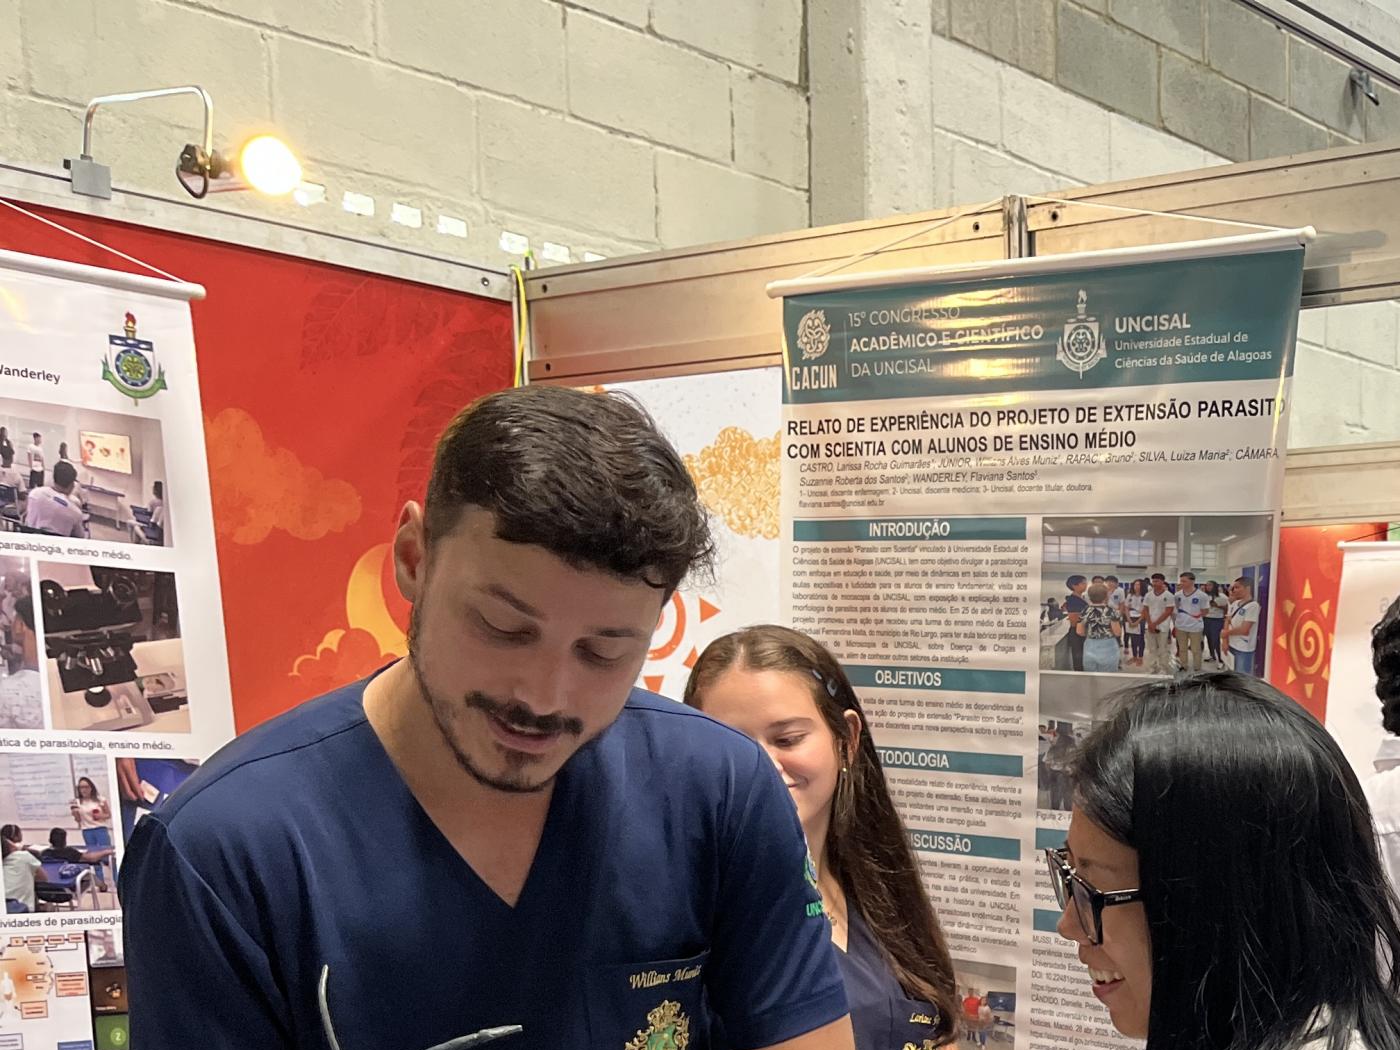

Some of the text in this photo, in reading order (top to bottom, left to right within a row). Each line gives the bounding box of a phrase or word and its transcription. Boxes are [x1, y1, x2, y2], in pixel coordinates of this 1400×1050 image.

[869, 307, 961, 326] CONGRESSO
[1115, 313, 1191, 333] UNCISAL
[850, 324, 1044, 353] ACADÊMICO E CIENTÍFICO
[1115, 332, 1249, 351] Universidade Estadual de
[851, 358, 936, 378] DA UNCISAL
[1115, 357, 1157, 369] Ciências
[1159, 355, 1173, 366] da
[1175, 352, 1206, 365] Saúde
[1210, 351, 1224, 363] de
[1227, 350, 1272, 365] Alagoas
[790, 364, 838, 391] CACUN
[787, 418, 842, 436] RELATO
[846, 417, 865, 433] DE
[870, 411, 965, 433] EXPERIÊNCIA
[969, 411, 992, 428] DO
[997, 407, 1070, 427] PROJETO
[1075, 406, 1098, 423] DE
[1103, 398, 1192, 423] EXTENSÃO
[787, 428, 1137, 460] COM SCIENTIA COM ALUNOS DE ENSINO MÉDIO
[1170, 450, 1196, 462] Luiza
[864, 472, 877, 486] dos
[969, 470, 1004, 483] Flaviana
[869, 519, 951, 540] INTRODUÇÃO
[67, 547, 100, 558] ensino
[874, 669, 942, 688] OBJETIVOS
[24, 738, 37, 749] de
[108, 741, 141, 751] ensino
[879, 750, 950, 769] TODOLOGIA
[909, 833, 972, 853] ISCUSSÃO
[44, 915, 58, 926] de
